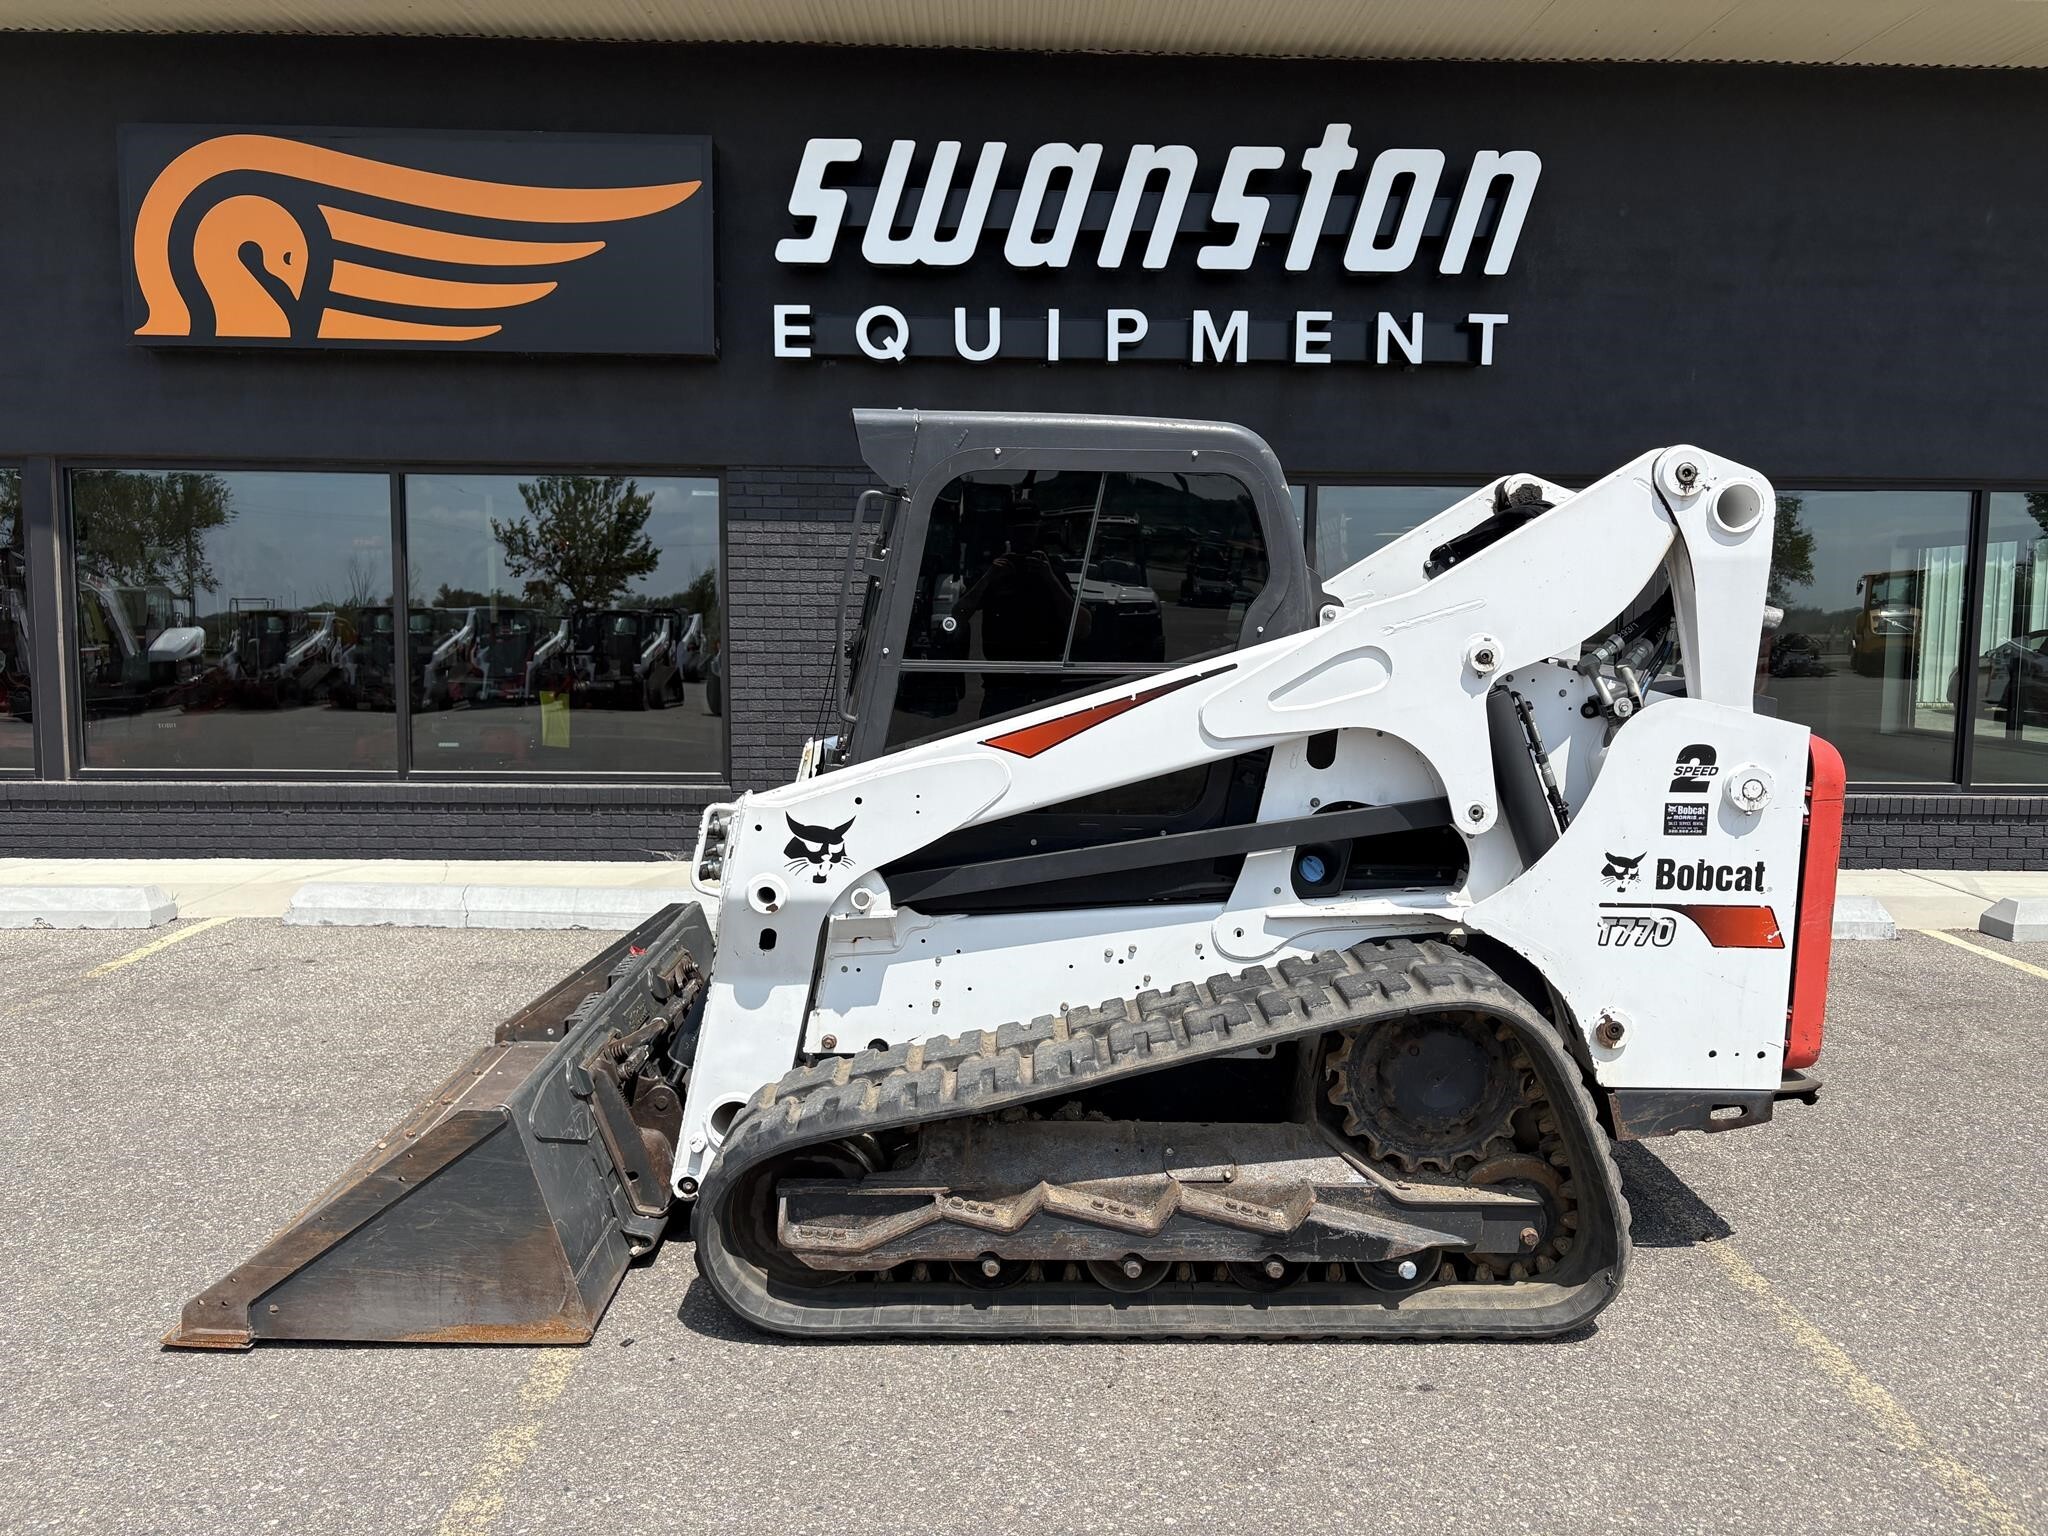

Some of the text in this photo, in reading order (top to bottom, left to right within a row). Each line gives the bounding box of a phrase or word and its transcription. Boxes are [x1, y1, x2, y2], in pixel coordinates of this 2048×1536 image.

[774, 123, 1542, 275] swanston
[773, 304, 1509, 366] EQUIPMENT
[1669, 744, 1717, 793] 2
[1673, 766, 1719, 776] SPEED
[1677, 805, 1706, 814] Bobcat
[1656, 858, 1766, 893] Bobcat
[1598, 916, 1677, 947] T770
